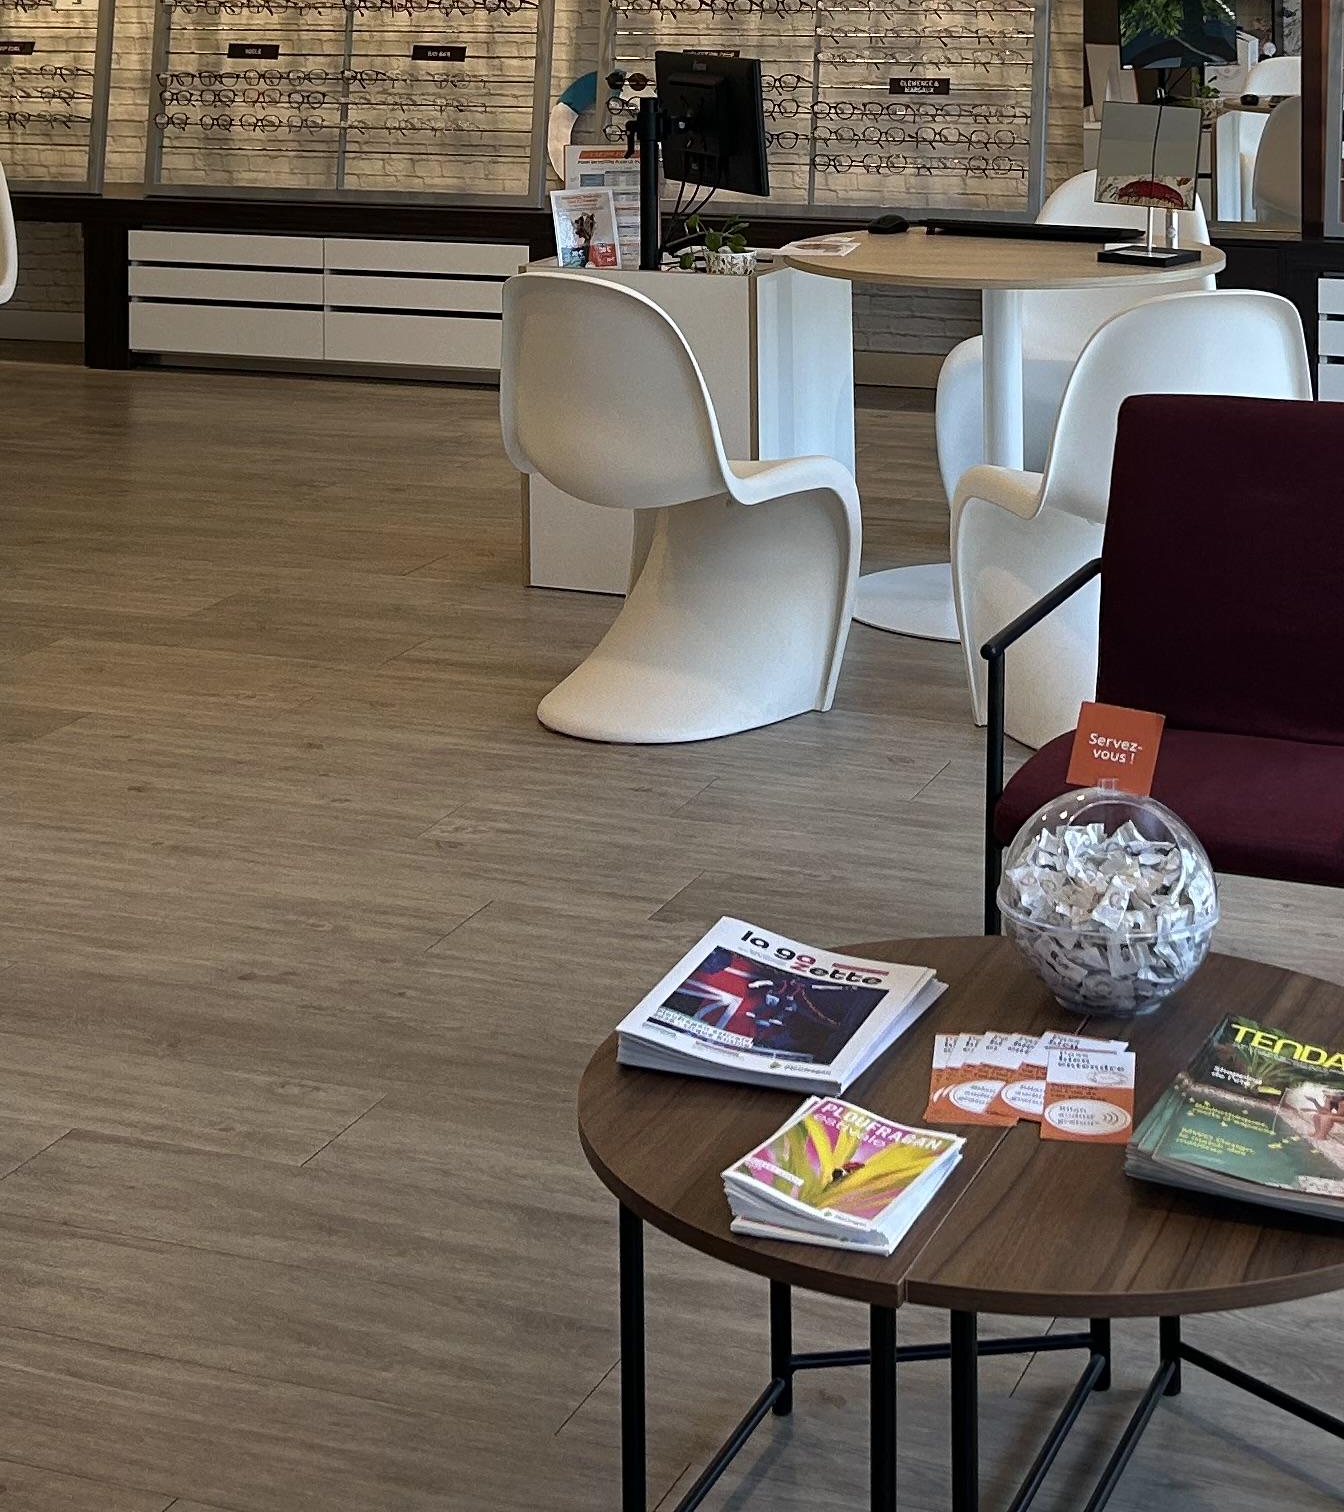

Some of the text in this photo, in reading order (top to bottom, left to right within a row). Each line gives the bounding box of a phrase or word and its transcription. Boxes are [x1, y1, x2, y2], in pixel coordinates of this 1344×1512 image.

[1088, 733, 1143, 752] Servez-
[1093, 749, 1126, 763] vous
[741, 930, 770, 949] la
[821, 1101, 944, 1152] PLOUFRAGAN
